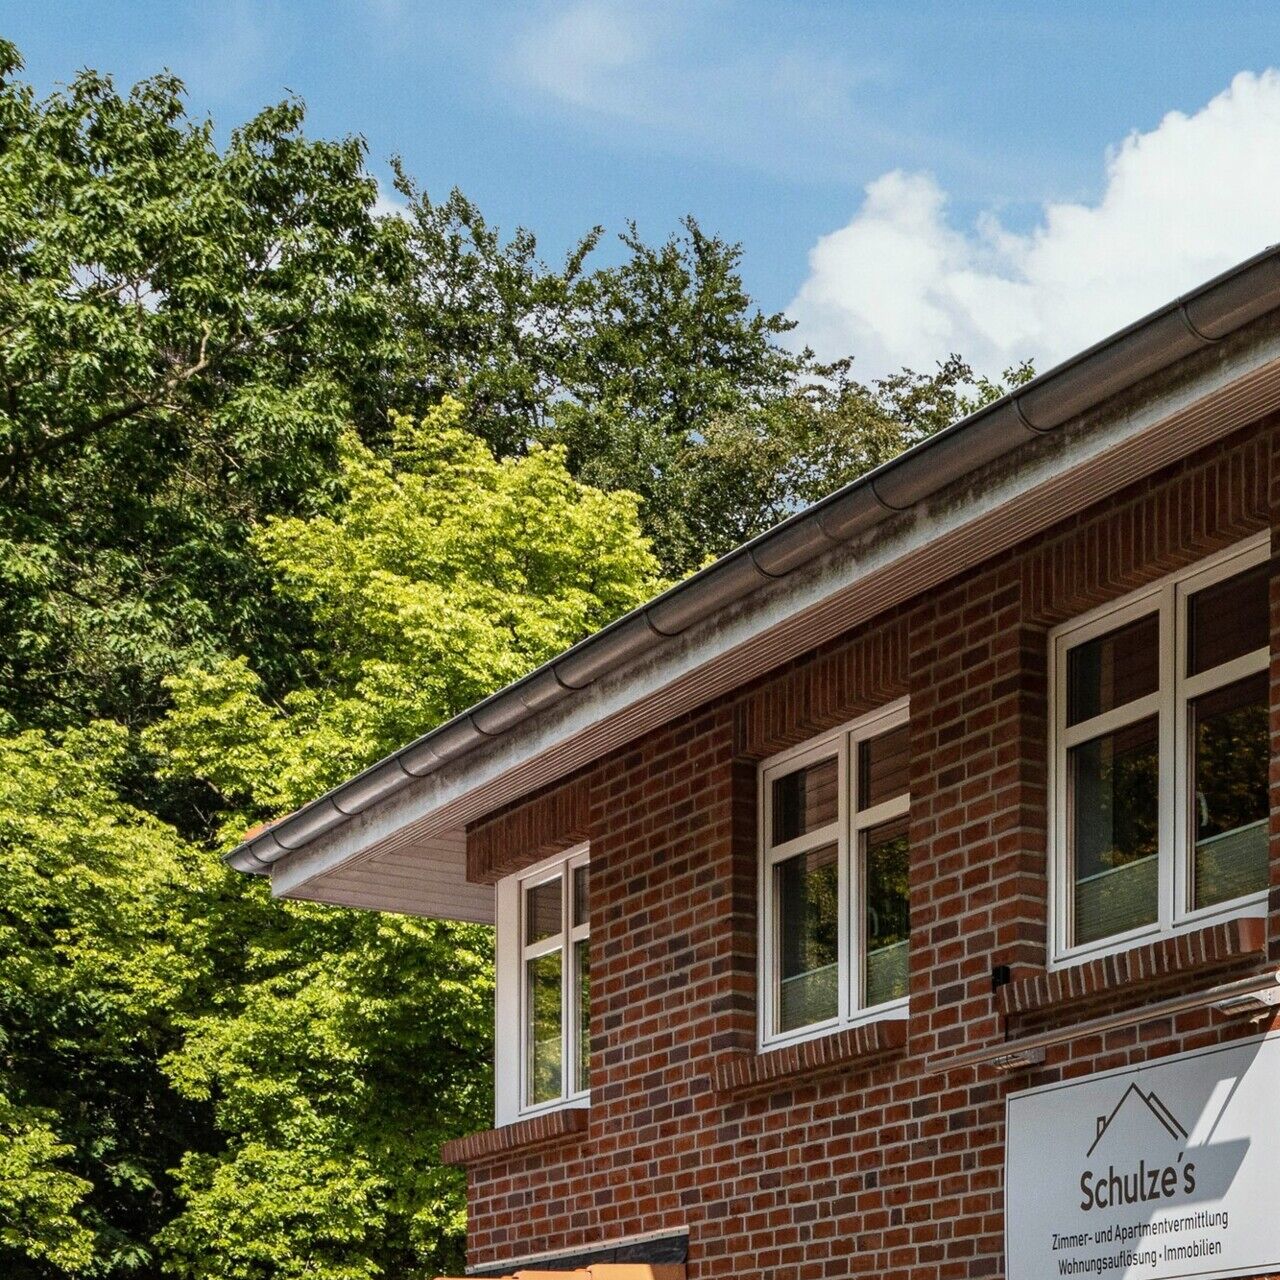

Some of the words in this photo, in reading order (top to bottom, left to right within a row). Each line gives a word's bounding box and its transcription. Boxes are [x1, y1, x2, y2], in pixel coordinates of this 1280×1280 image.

[1080, 1152, 1196, 1211] Schulze's
[1052, 1233, 1093, 1250] Zimmer-
[1094, 1225, 1113, 1244] und
[1114, 1210, 1229, 1244] Apartmentvermittlung
[1058, 1249, 1158, 1275] Wohnungsauflösung
[1163, 1238, 1222, 1262] Immobilien
